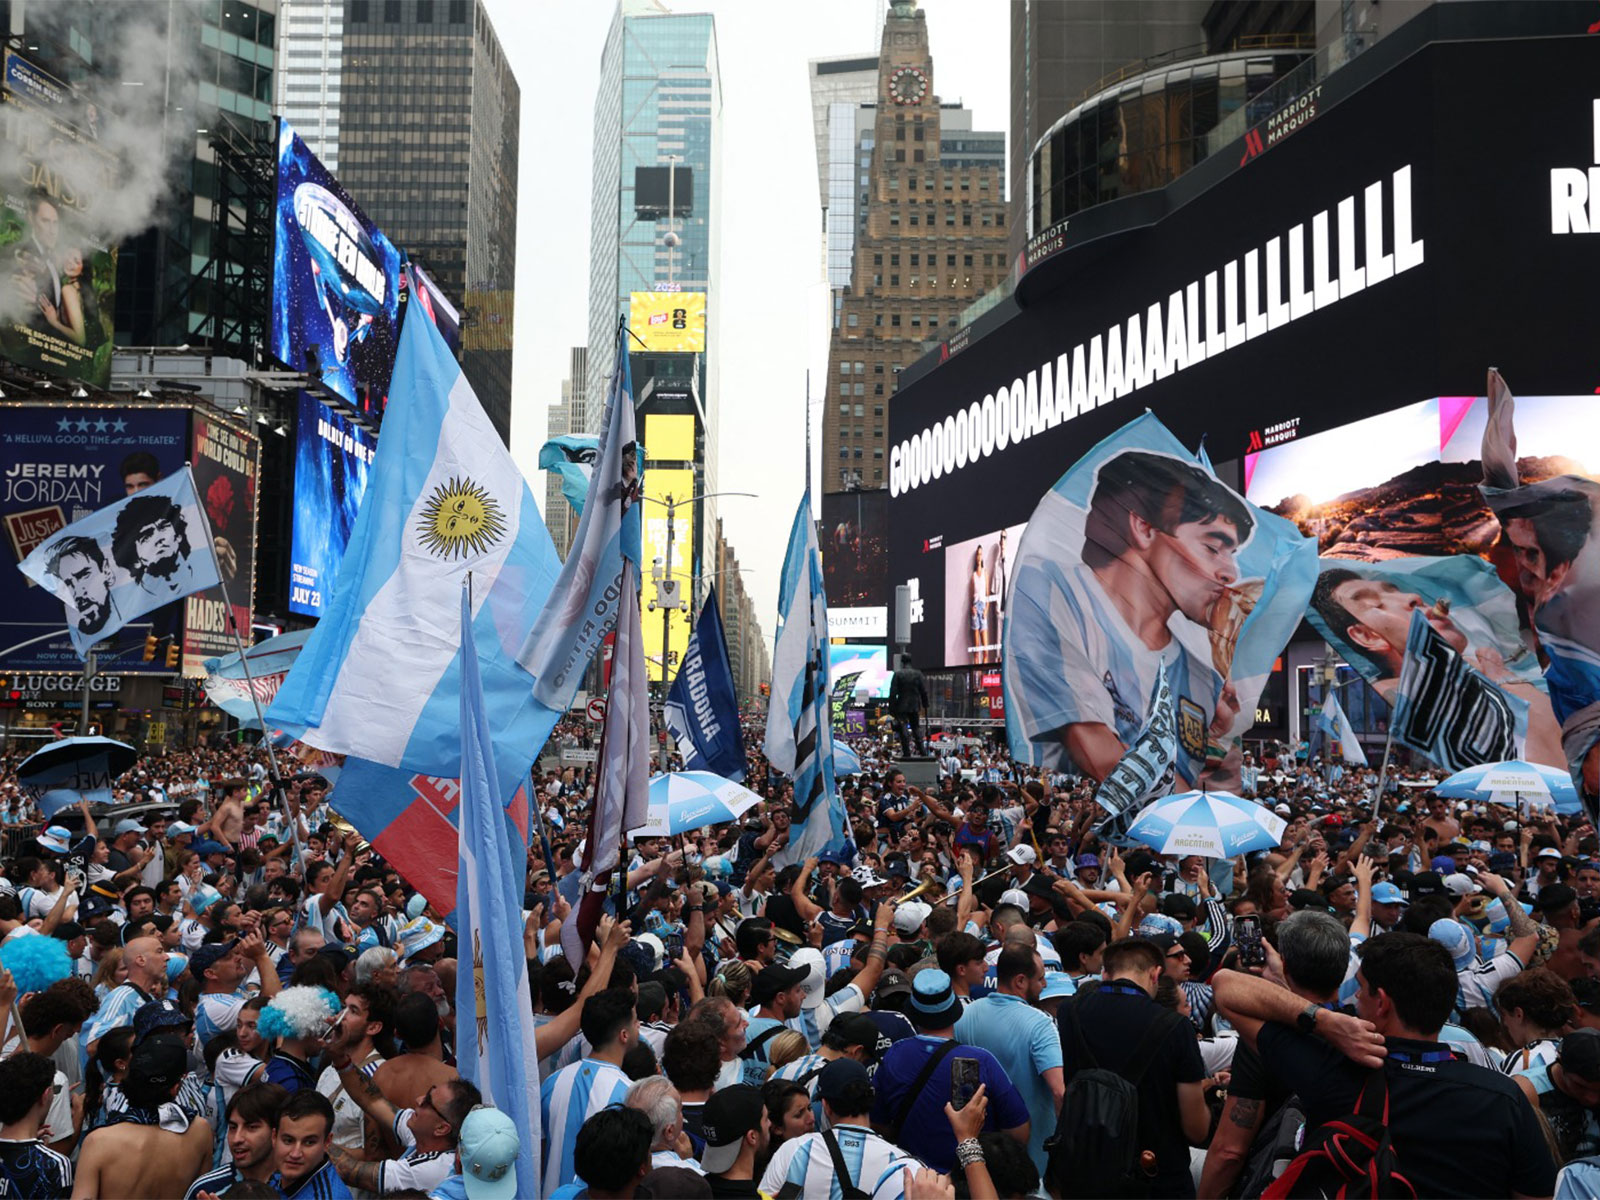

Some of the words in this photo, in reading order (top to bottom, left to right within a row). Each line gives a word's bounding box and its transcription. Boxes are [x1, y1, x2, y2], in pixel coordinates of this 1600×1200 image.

[11, 69, 43, 93] CORBIN
[43, 88, 63, 103] BLEU
[1268, 86, 1322, 130] MARRIOTT
[1268, 106, 1316, 144] MARQUIS
[1028, 221, 1070, 252] MARRIOTT
[1028, 237, 1063, 265] MARQUIS
[1264, 417, 1301, 436] MARRIOTT
[1264, 429, 1297, 446] MARQUIS
[15, 434, 52, 443] HELLUVA
[55, 435, 88, 444] GOOD
[90, 436, 110, 444] TIME
[197, 433, 223, 463] WORLD
[5, 463, 106, 478] JEREMY
[4, 479, 102, 503] JORDAN
[292, 586, 311, 607] JULY
[310, 591, 321, 608] 23
[12, 676, 121, 692] LUGGAGE
[1174, 838, 1215, 849] ARGENTINA
